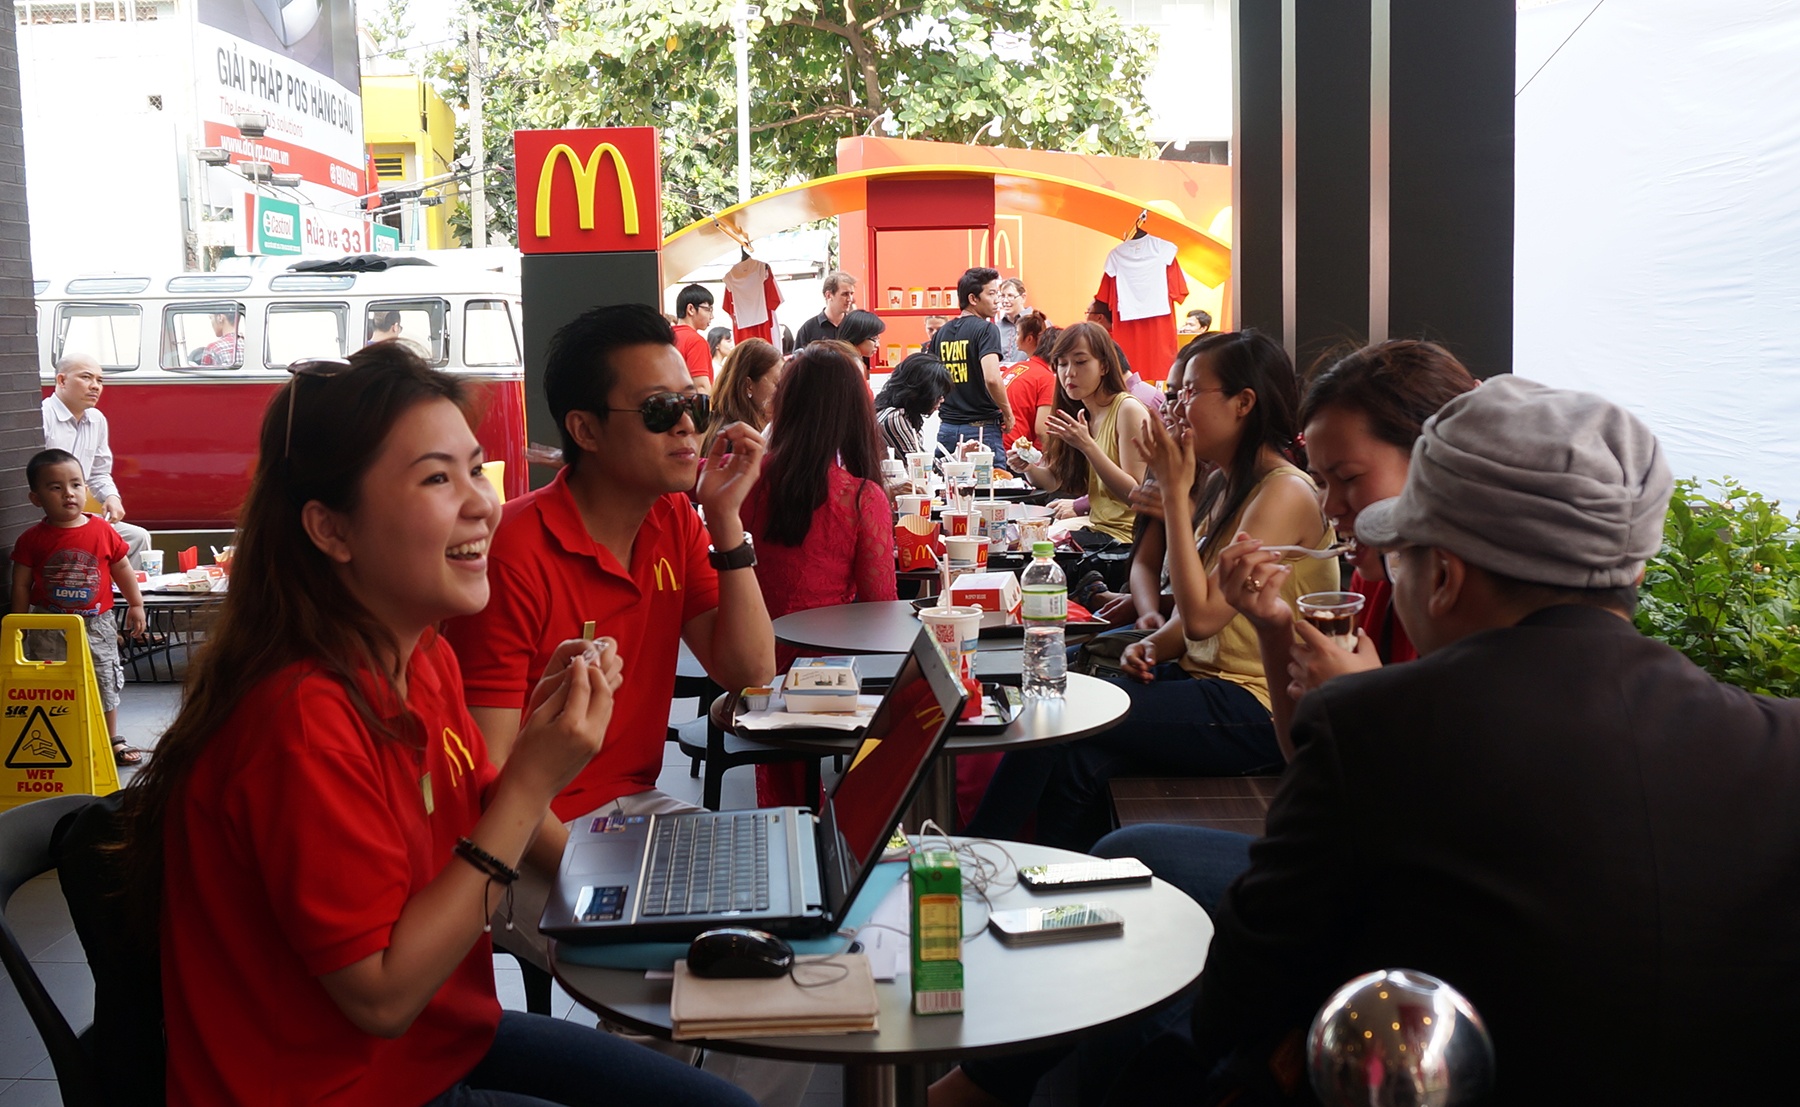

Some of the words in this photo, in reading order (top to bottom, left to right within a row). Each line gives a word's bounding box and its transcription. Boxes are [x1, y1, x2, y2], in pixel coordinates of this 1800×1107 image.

[217, 42, 246, 92] GIẢI
[249, 58, 283, 104] PHÁP
[286, 73, 308, 114] POS
[310, 79, 337, 126] HÀNG
[220, 95, 235, 117] The
[276, 115, 304, 138] solutions
[535, 142, 640, 238] M
[270, 214, 292, 236] Castrol
[327, 227, 339, 249] xe
[341, 227, 362, 254] 33
[940, 339, 969, 362] EVENT
[945, 362, 969, 384] REW
[8, 688, 75, 701] CAUTION
[25, 769, 55, 780] WET
[17, 782, 64, 793] FLOOR
